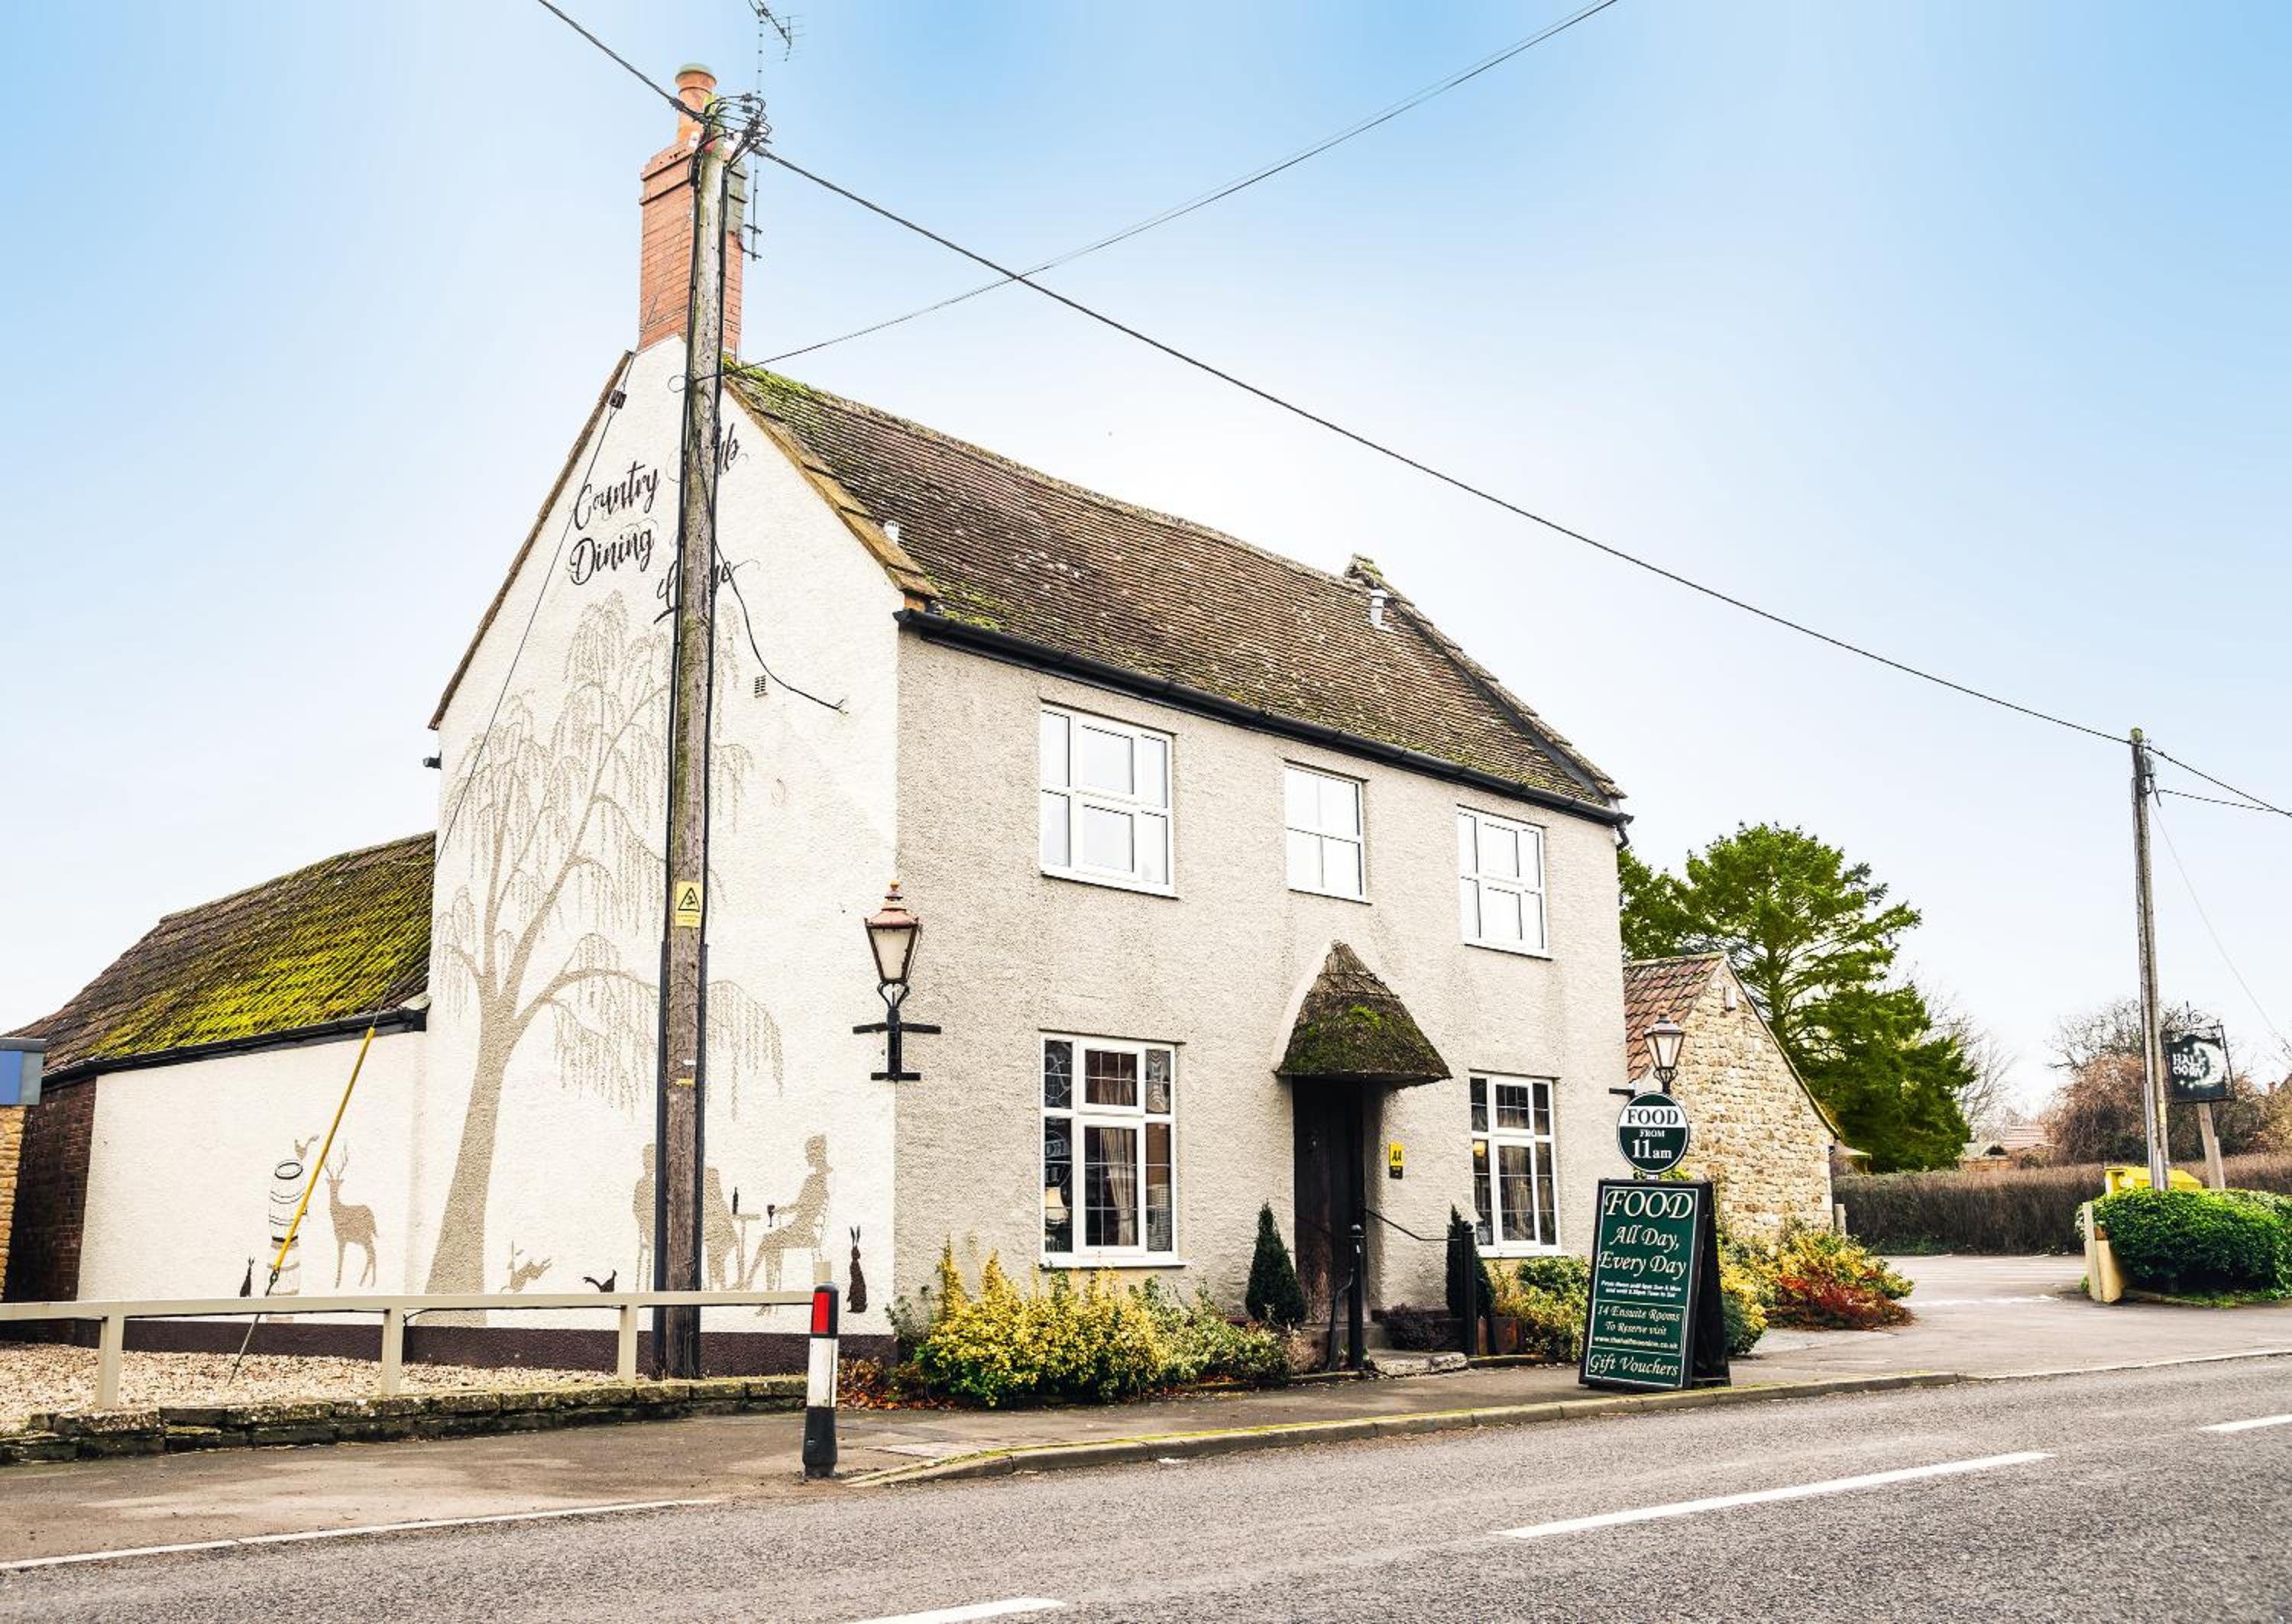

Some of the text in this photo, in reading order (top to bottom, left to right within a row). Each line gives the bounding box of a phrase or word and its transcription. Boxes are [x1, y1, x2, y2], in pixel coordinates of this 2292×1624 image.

[575, 461, 660, 530] Country
[567, 523, 656, 585] Dining
[2172, 1053, 2206, 1066] HALF
[1627, 1108, 1679, 1125] FOOD
[1639, 1129, 1666, 1137] FROM
[1631, 1139, 1672, 1160] 11am
[1605, 1190, 1694, 1218] FOOD
[1609, 1224, 1681, 1253] All Day,
[1599, 1250, 1687, 1281] Every Day
[1598, 1305, 1681, 1322] 14 Ensuite Rooms
[1605, 1321, 1667, 1335] To Reserve visit
[1589, 1353, 1679, 1377] Gift Vouchers
